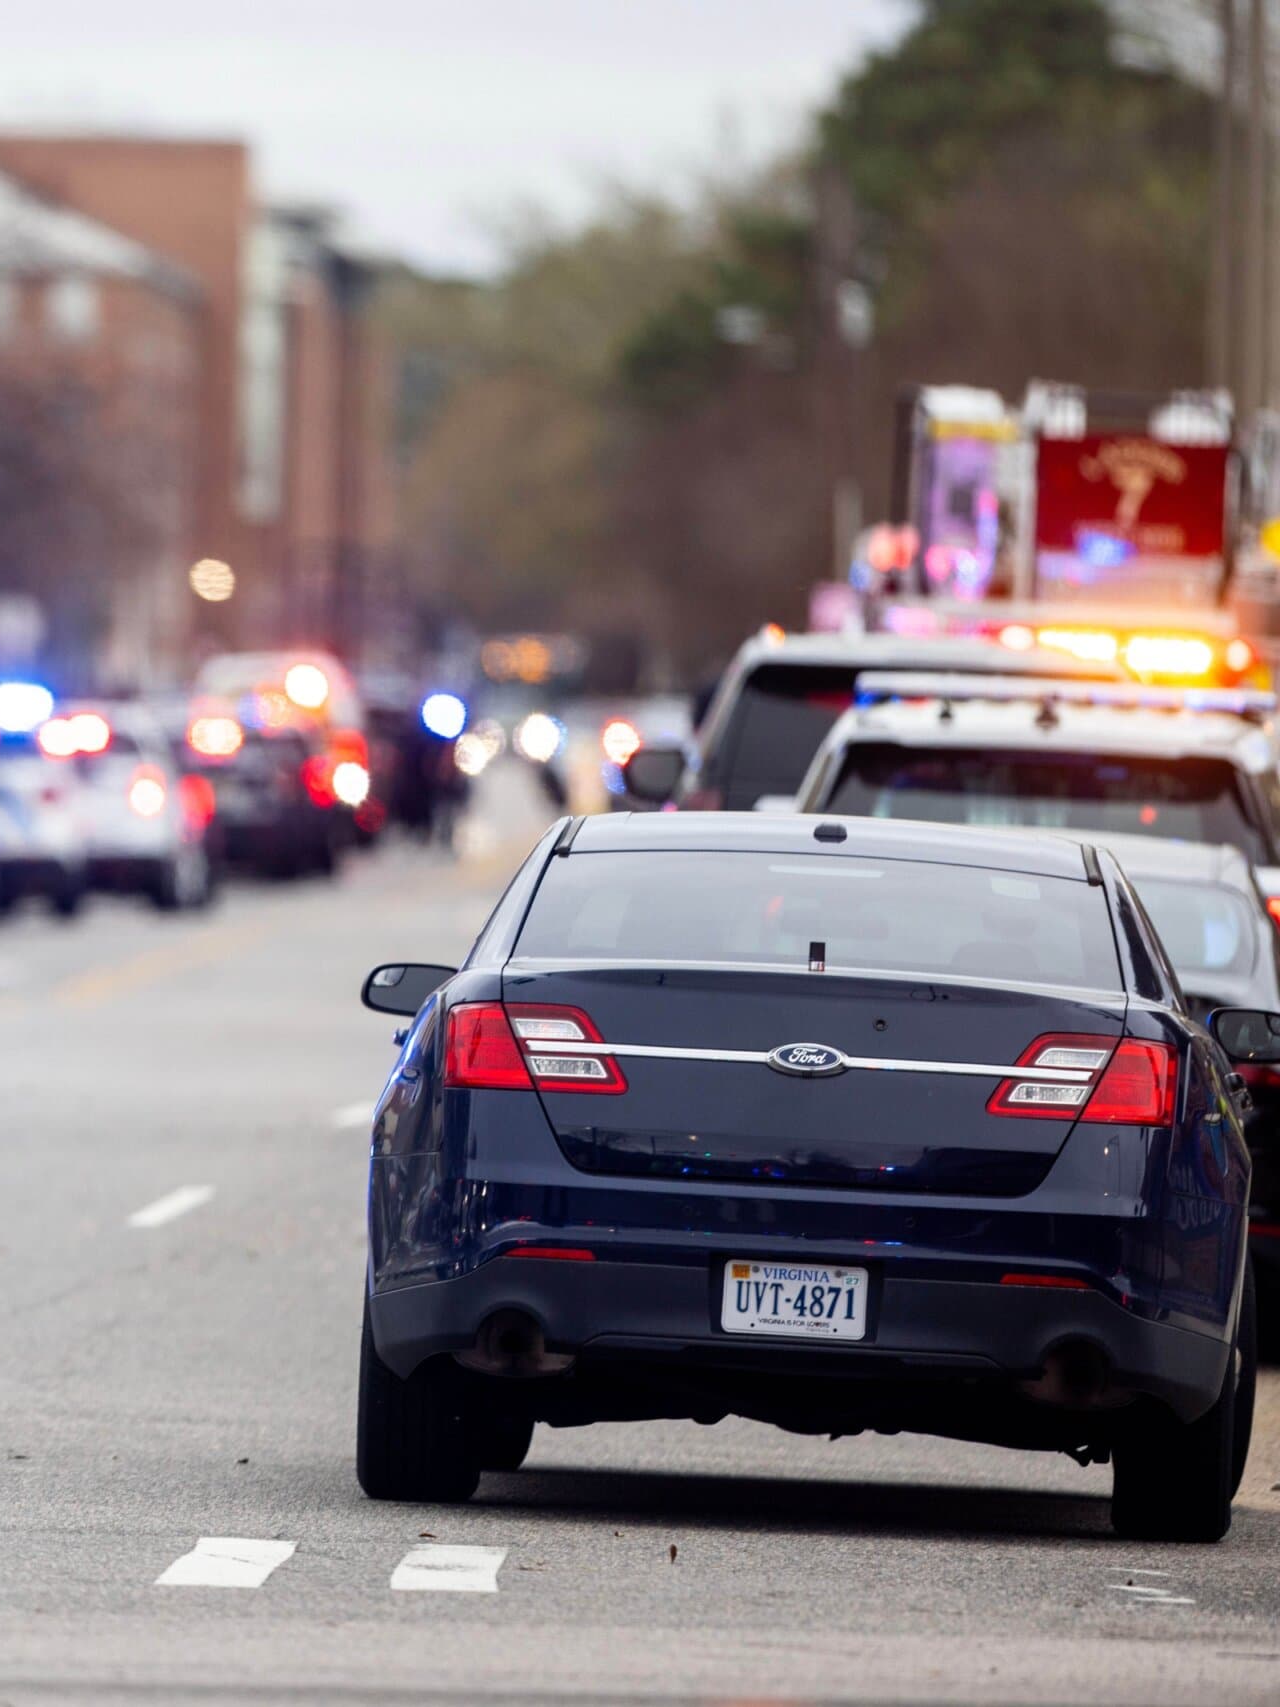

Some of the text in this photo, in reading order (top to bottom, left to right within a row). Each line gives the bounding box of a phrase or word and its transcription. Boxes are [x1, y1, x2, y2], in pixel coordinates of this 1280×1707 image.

[789, 1047, 827, 1064] Ford
[763, 1267, 829, 1282] VIRGINIA
[845, 1277, 859, 1285] 27
[736, 1280, 855, 1320] UVT-4871
